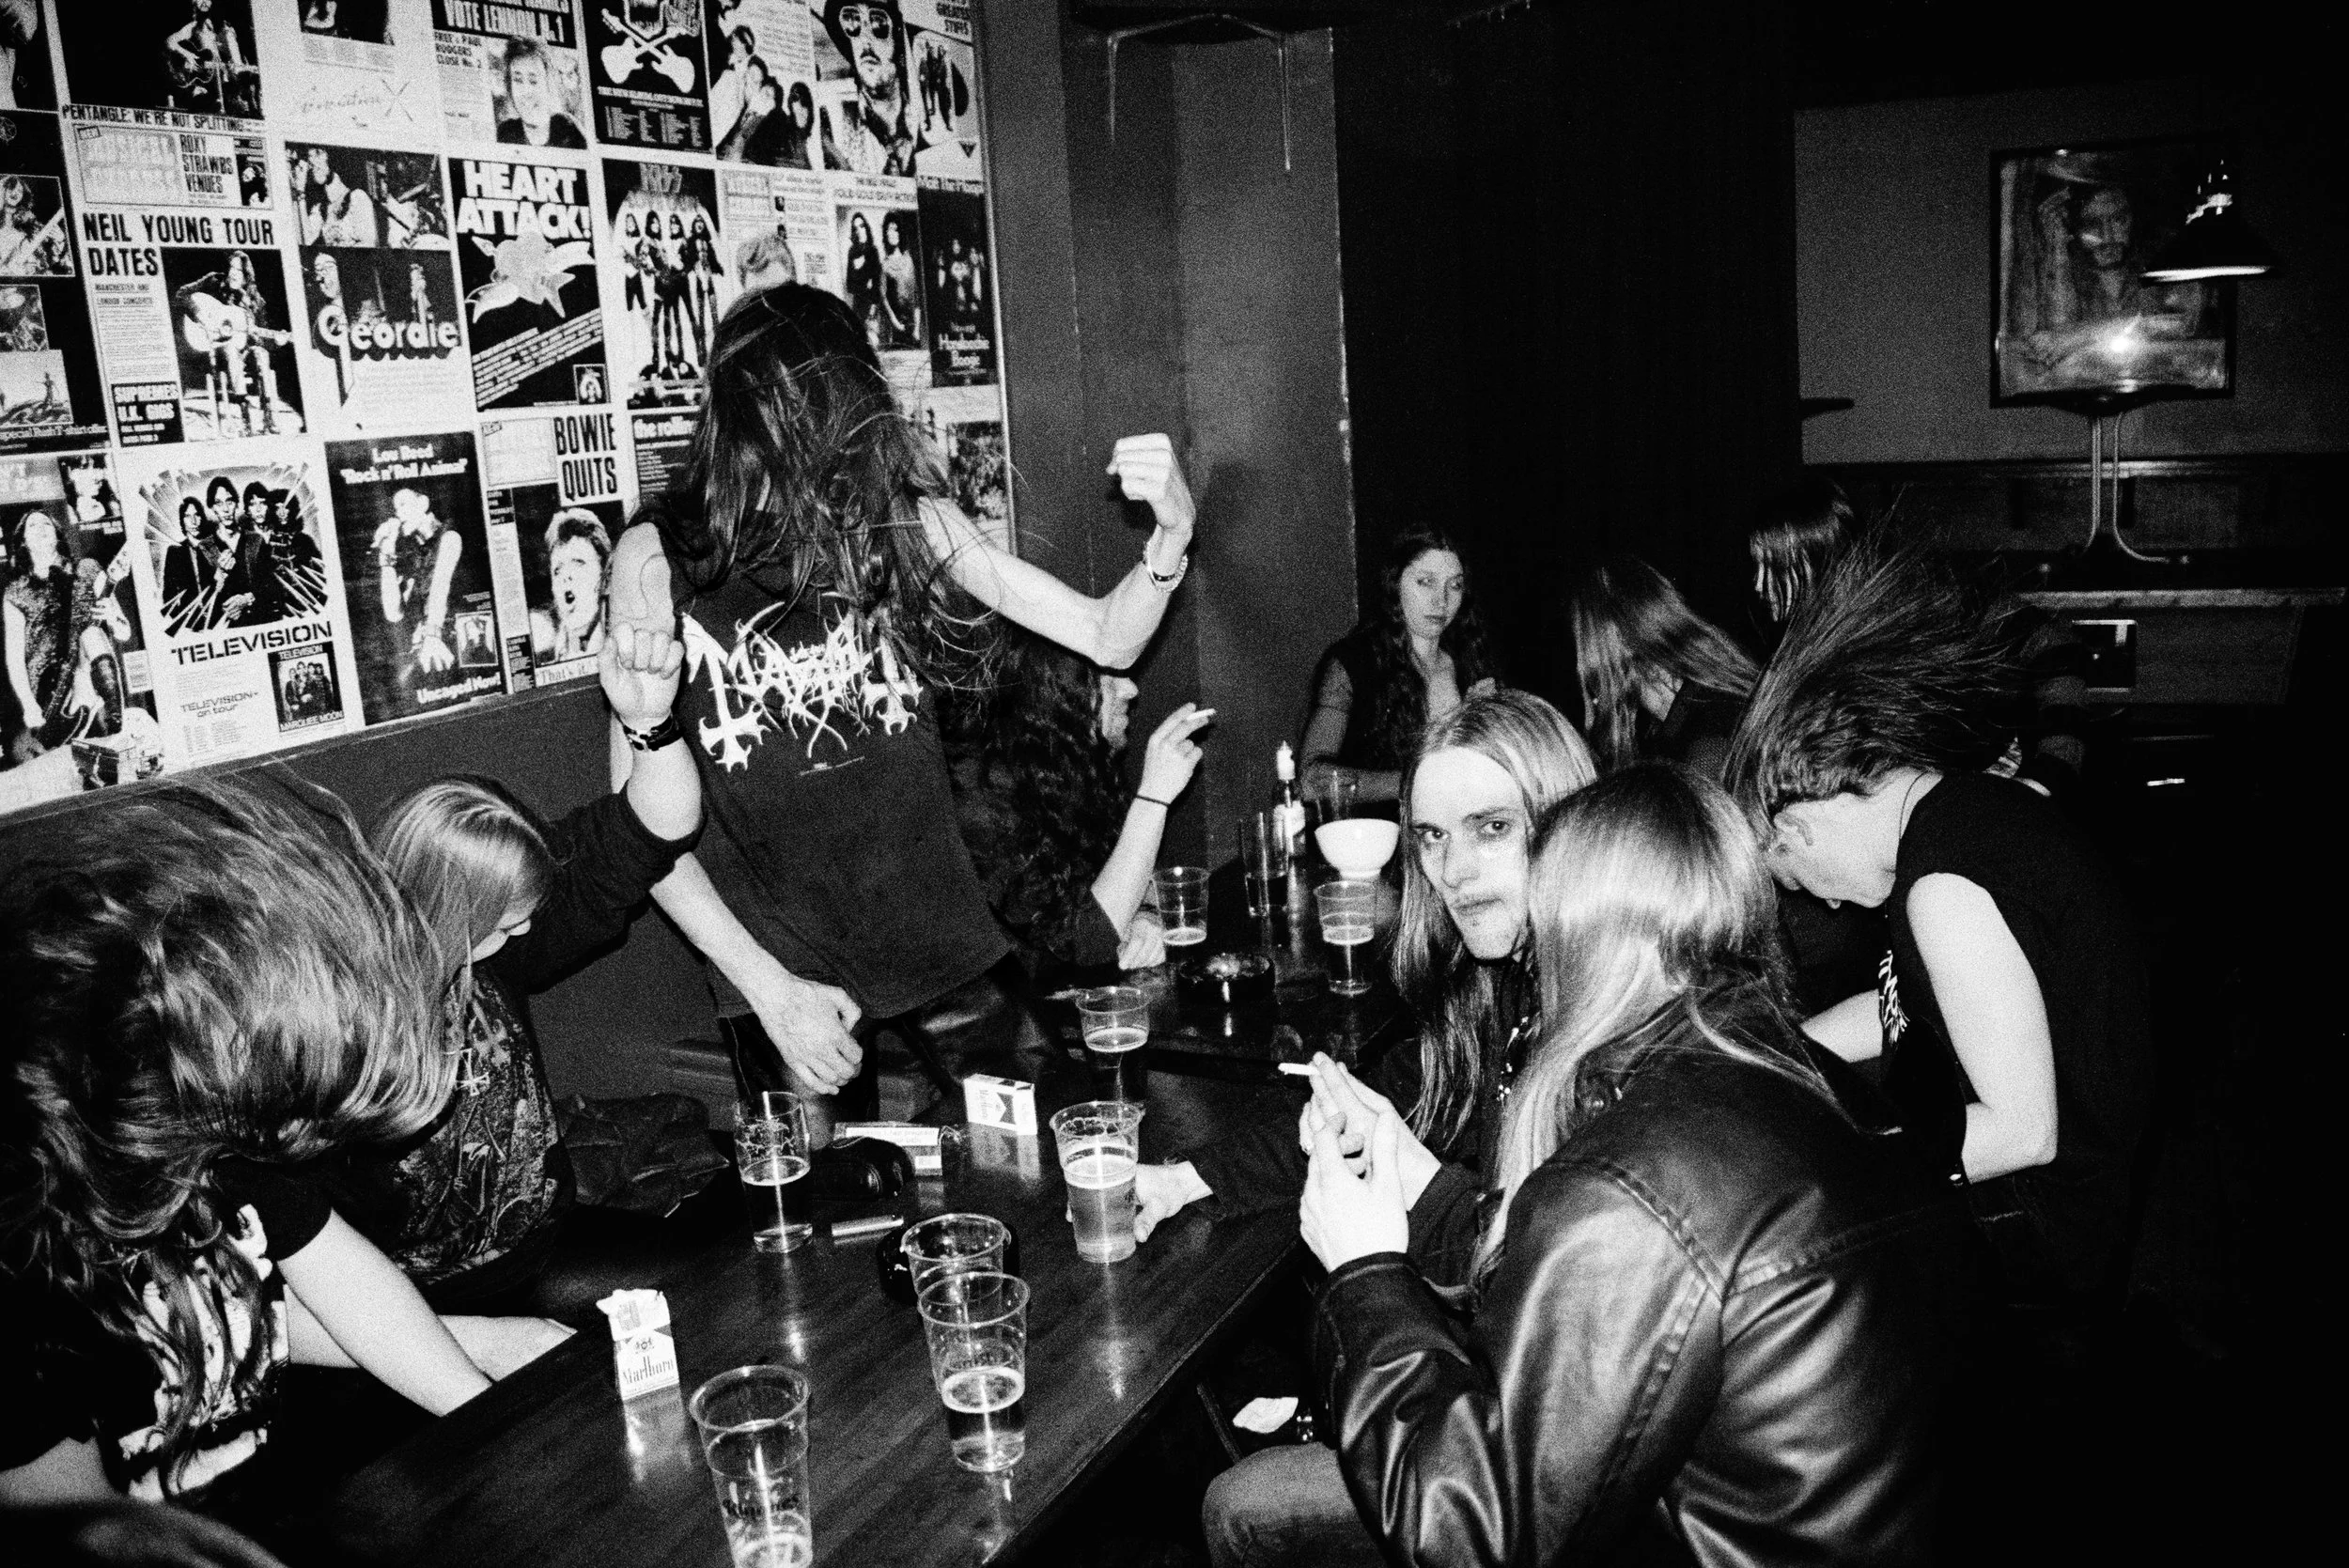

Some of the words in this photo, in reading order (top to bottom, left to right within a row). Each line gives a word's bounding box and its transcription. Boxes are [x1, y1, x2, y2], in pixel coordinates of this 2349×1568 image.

[172, 113, 192, 128] NOT
[179, 133, 208, 153] ROXY
[181, 153, 234, 175] STRAWBS
[184, 173, 224, 194] VENUES
[462, 159, 578, 204] HEART
[83, 212, 132, 242] NEIL
[141, 214, 213, 244] YOUNG
[222, 217, 274, 245] TOUR
[457, 197, 592, 239] ATTACK!
[87, 246, 160, 276] DATES
[317, 304, 459, 387] Geordie
[553, 413, 616, 456] BOWIE
[371, 447, 398, 463] Lou
[399, 443, 434, 460] Reed
[562, 457, 617, 501] QUITS
[171, 620, 333, 665] TELEVISION
[278, 644, 323, 660] TELEVISION
[213, 703, 239, 715] tour
